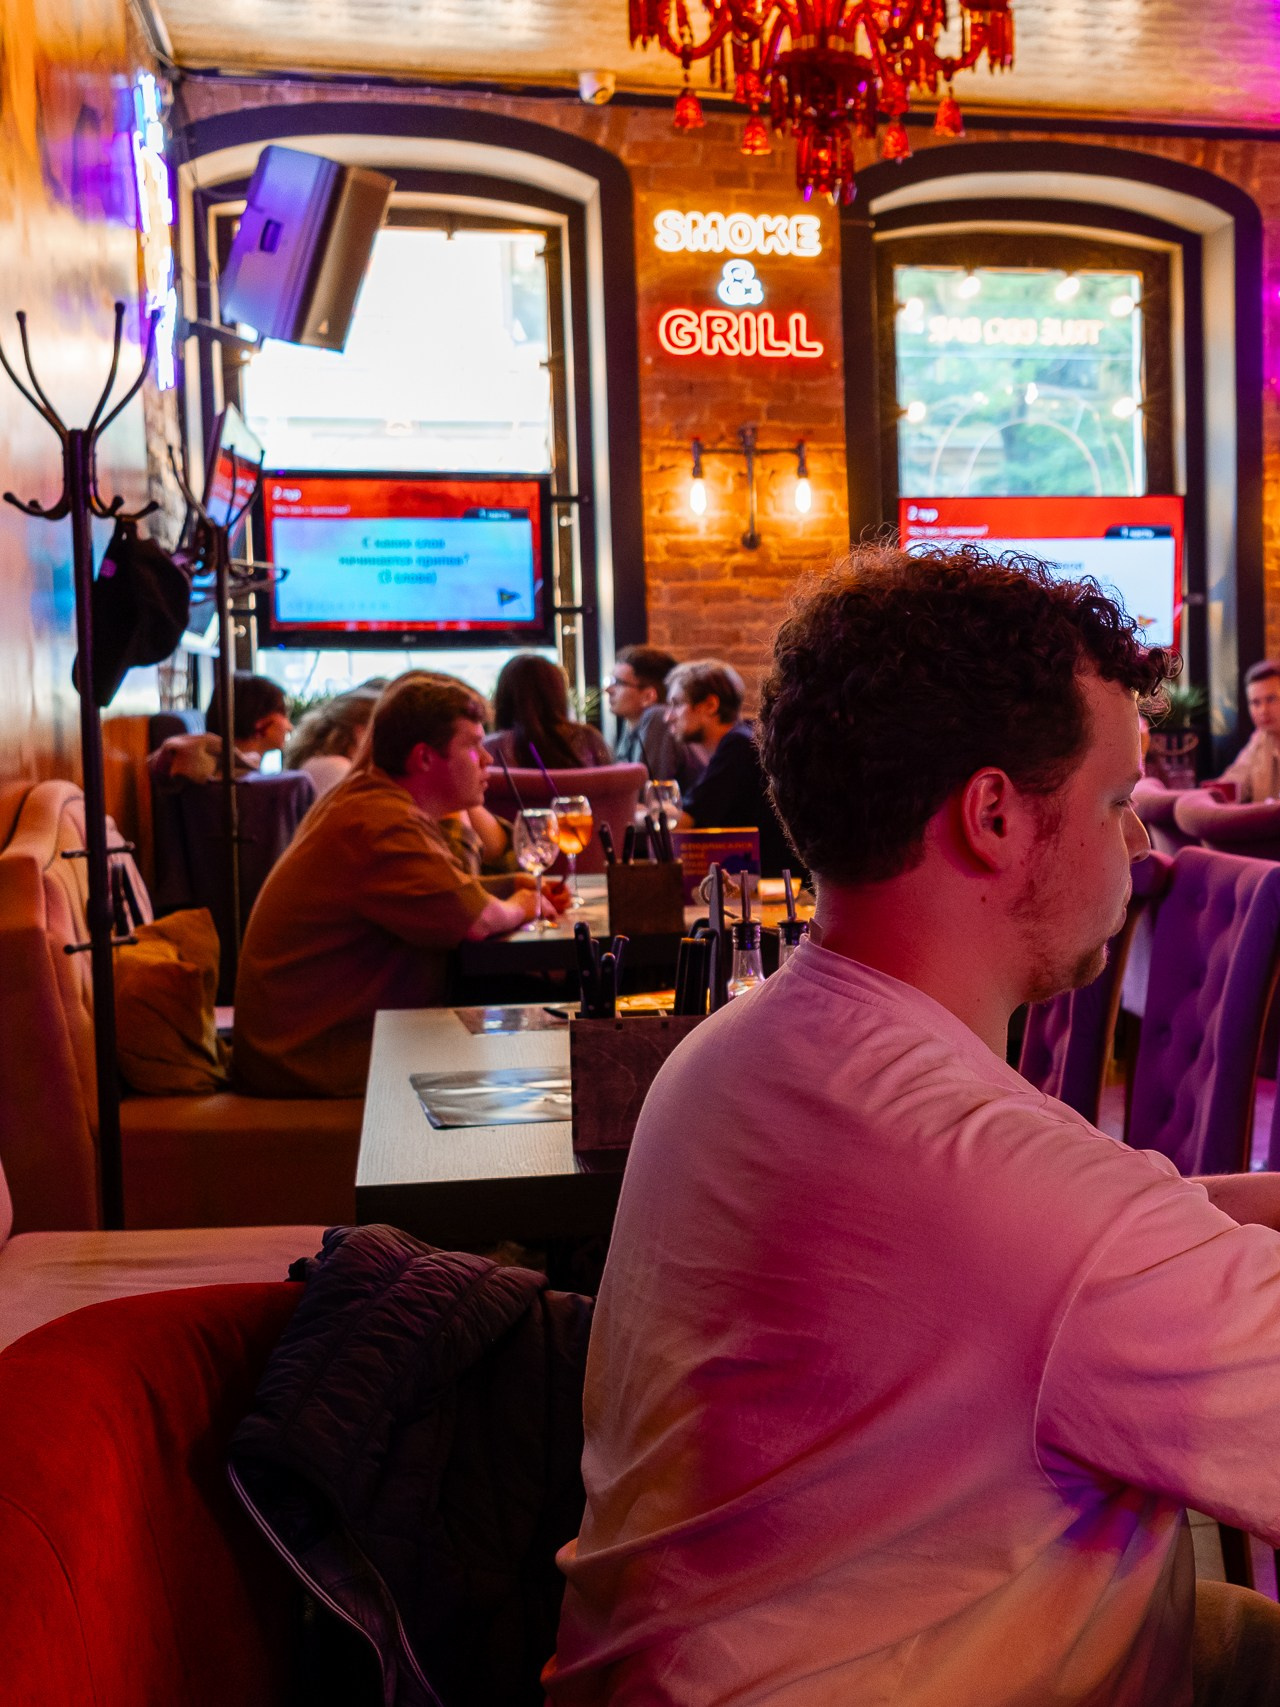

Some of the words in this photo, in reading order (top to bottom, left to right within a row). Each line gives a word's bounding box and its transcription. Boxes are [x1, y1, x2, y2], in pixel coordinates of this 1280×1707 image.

[654, 210, 822, 257] SMOKE
[718, 259, 764, 305] &
[659, 308, 823, 358] GRILL
